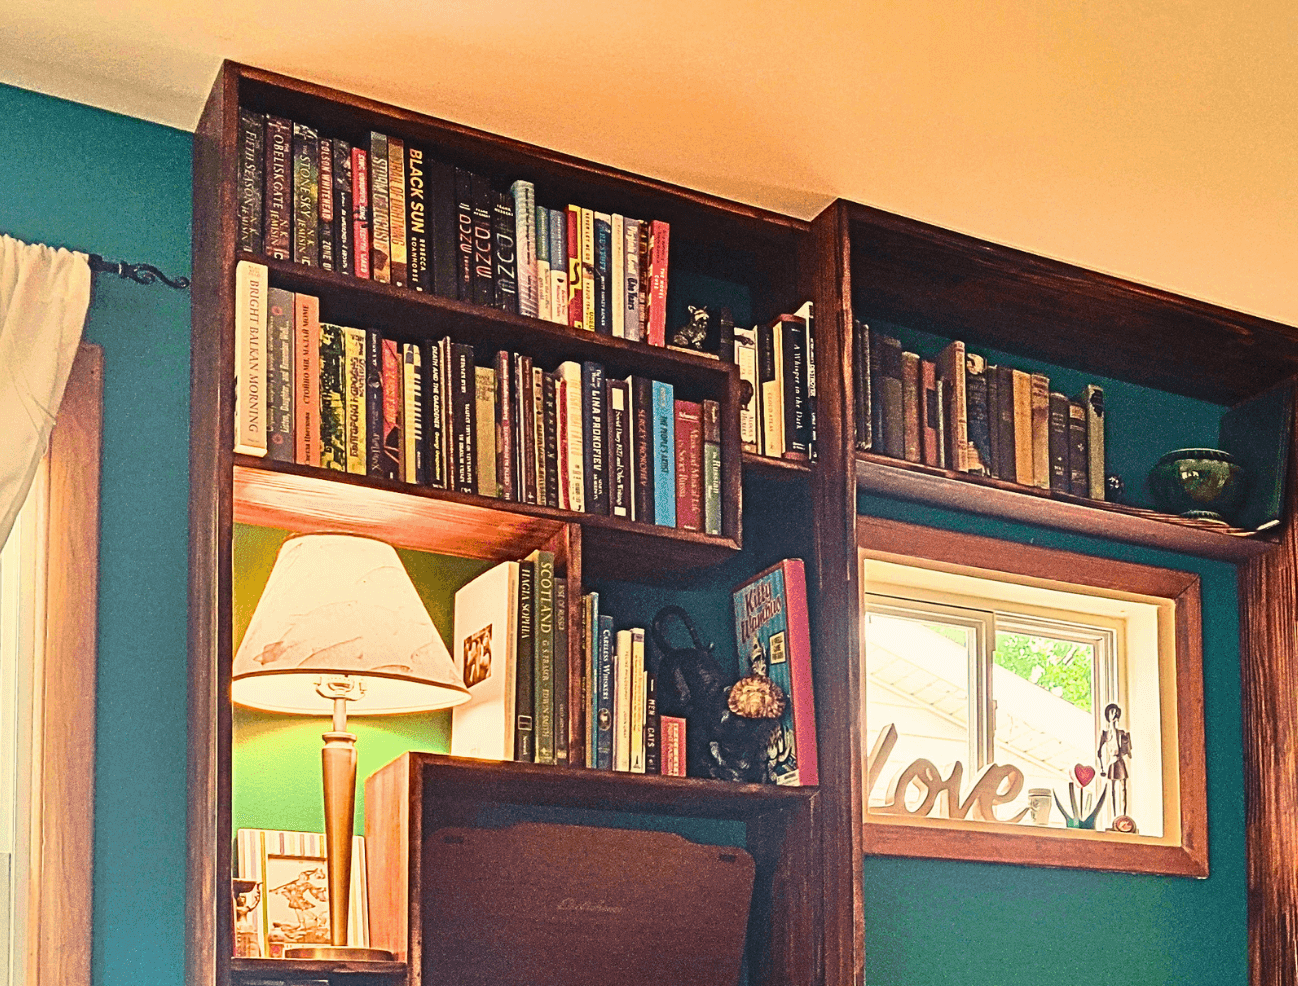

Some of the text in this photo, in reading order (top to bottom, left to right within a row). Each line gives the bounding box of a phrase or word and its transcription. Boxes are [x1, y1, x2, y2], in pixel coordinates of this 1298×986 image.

[272, 134, 285, 211] OBELISK GATE
[299, 154, 312, 218] STONE SKY
[320, 140, 333, 220] COLSON WHITEHEAD
[373, 157, 389, 193] STORM
[409, 148, 425, 234] BLACK SUN
[390, 160, 406, 247] TRAIL OF LIGHTNING
[270, 210, 281, 246] JEMISIN
[297, 218, 308, 253] JEMISIN
[419, 238, 427, 271] REBECCA
[627, 277, 639, 311] The Years
[659, 280, 667, 300] NOVEL
[249, 280, 260, 433] BRIGHT BALKAN MORNING
[432, 346, 440, 365] DEATH
[792, 353, 802, 384] Whisper
[591, 390, 602, 414] LINA
[795, 396, 803, 409] the
[796, 411, 804, 430] Dark
[592, 416, 603, 471] PROKOFIEV
[638, 409, 648, 487] SERGEY PROKOFIEV
[660, 415, 671, 475] THE PEOPLE'S ARTIST
[711, 459, 721, 494] Russian
[521, 568, 532, 640] HAGIA SOPHIA
[540, 561, 552, 634] SCOTLAND
[745, 581, 771, 618] Kitty
[648, 700, 657, 748] MEN CATS
